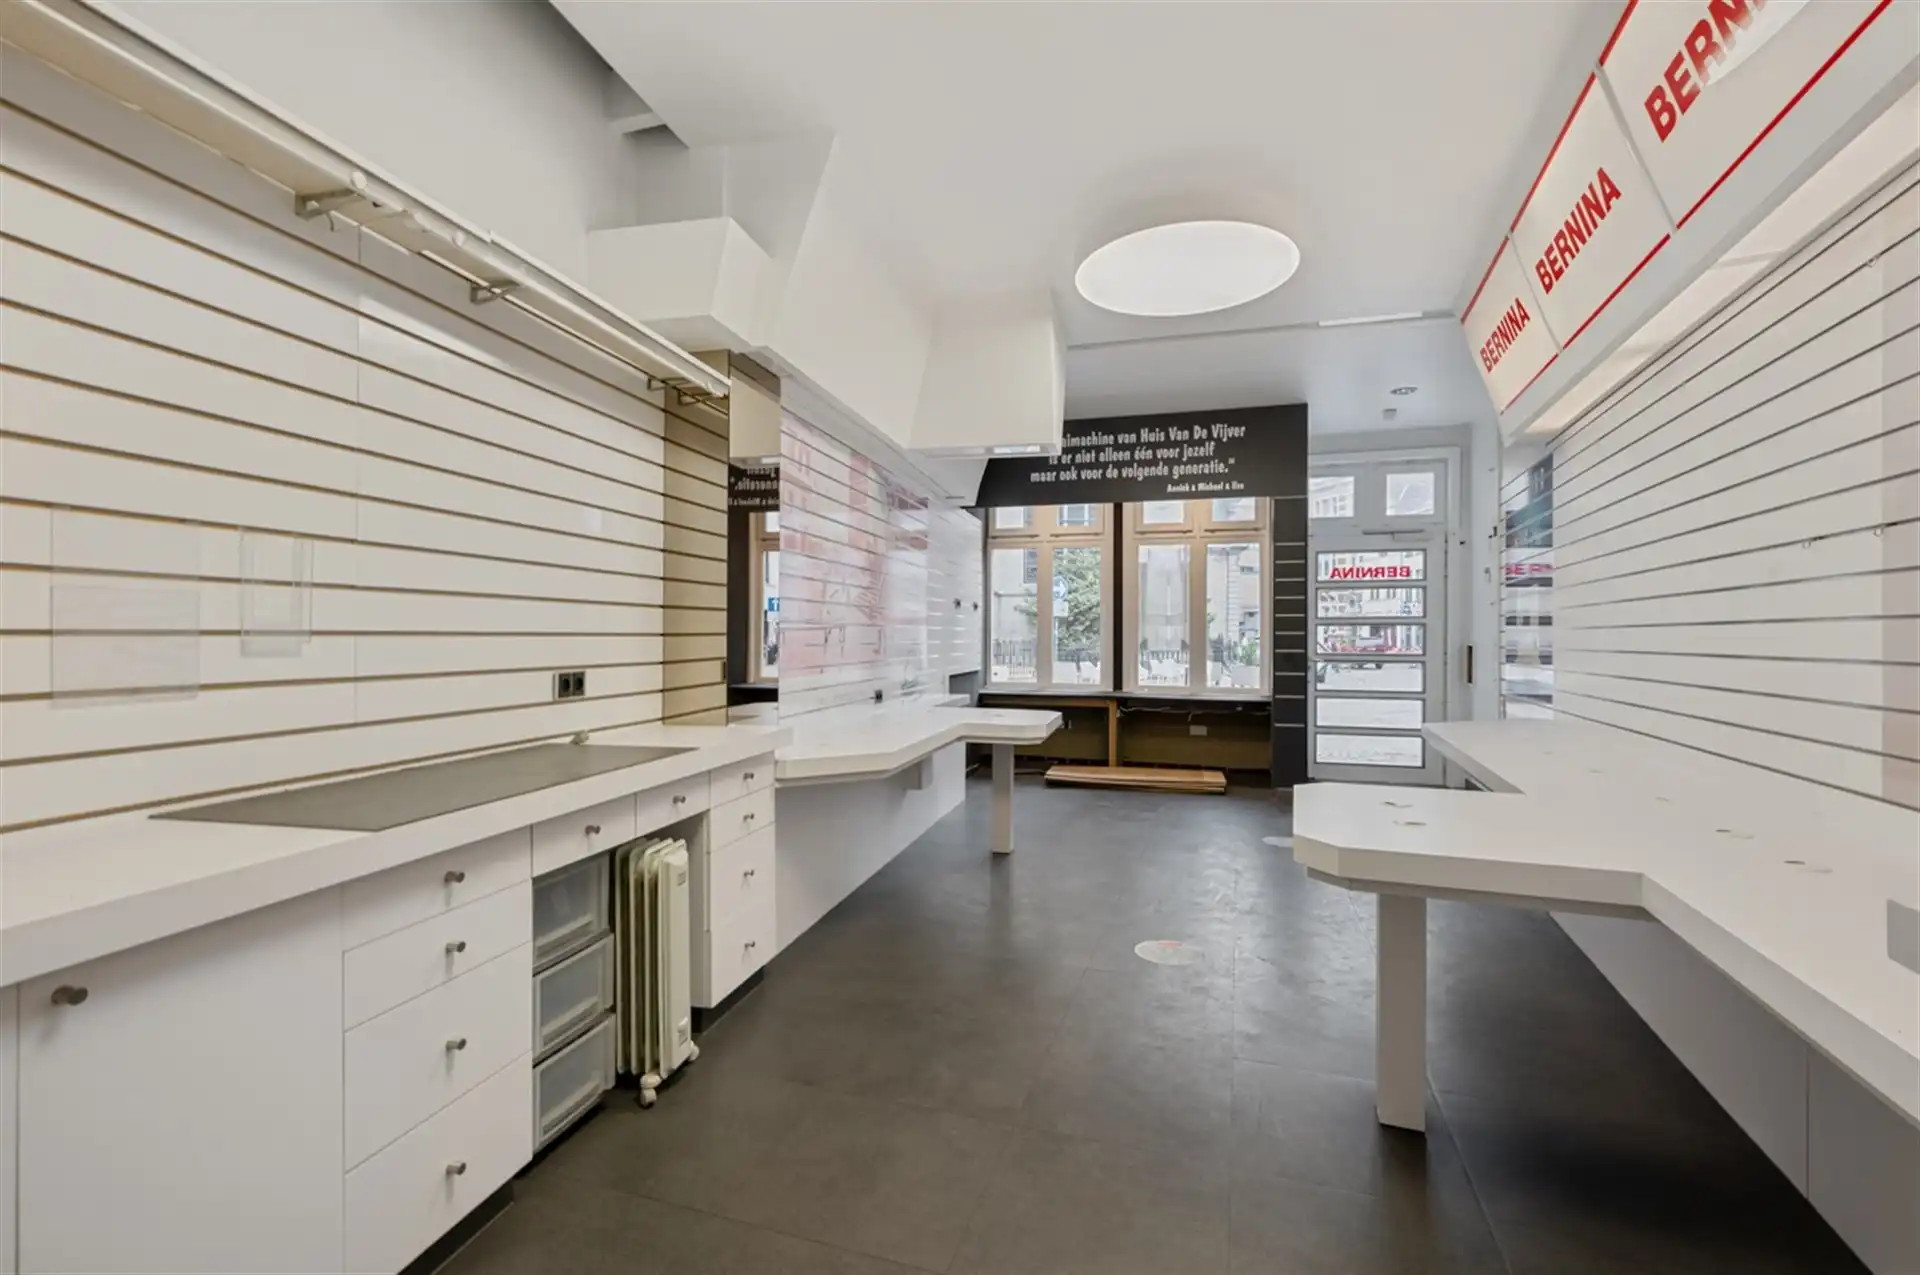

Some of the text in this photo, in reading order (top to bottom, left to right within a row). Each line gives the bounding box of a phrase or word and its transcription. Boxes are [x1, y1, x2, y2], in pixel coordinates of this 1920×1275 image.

[1644, 0, 1766, 143] BERN
[1534, 167, 1622, 294] BERNINA
[1479, 297, 1531, 373] BERNINA
[1061, 453, 1072, 464] er
[1075, 450, 1096, 464] niet
[1099, 447, 1131, 462] alleen
[1134, 446, 1153, 460] één
[1156, 446, 1180, 459] voor
[1183, 441, 1216, 461] jezelf
[1117, 433, 1136, 444] van
[1140, 427, 1165, 443] Huis
[1168, 426, 1190, 441] Van
[1193, 425, 1208, 440] De
[1211, 424, 1246, 442] Vijver
[1030, 471, 1057, 482] maar
[1060, 465, 1078, 481] ook
[1080, 468, 1103, 480] voor
[1105, 463, 1119, 479] de
[1121, 462, 1169, 481] volgende
